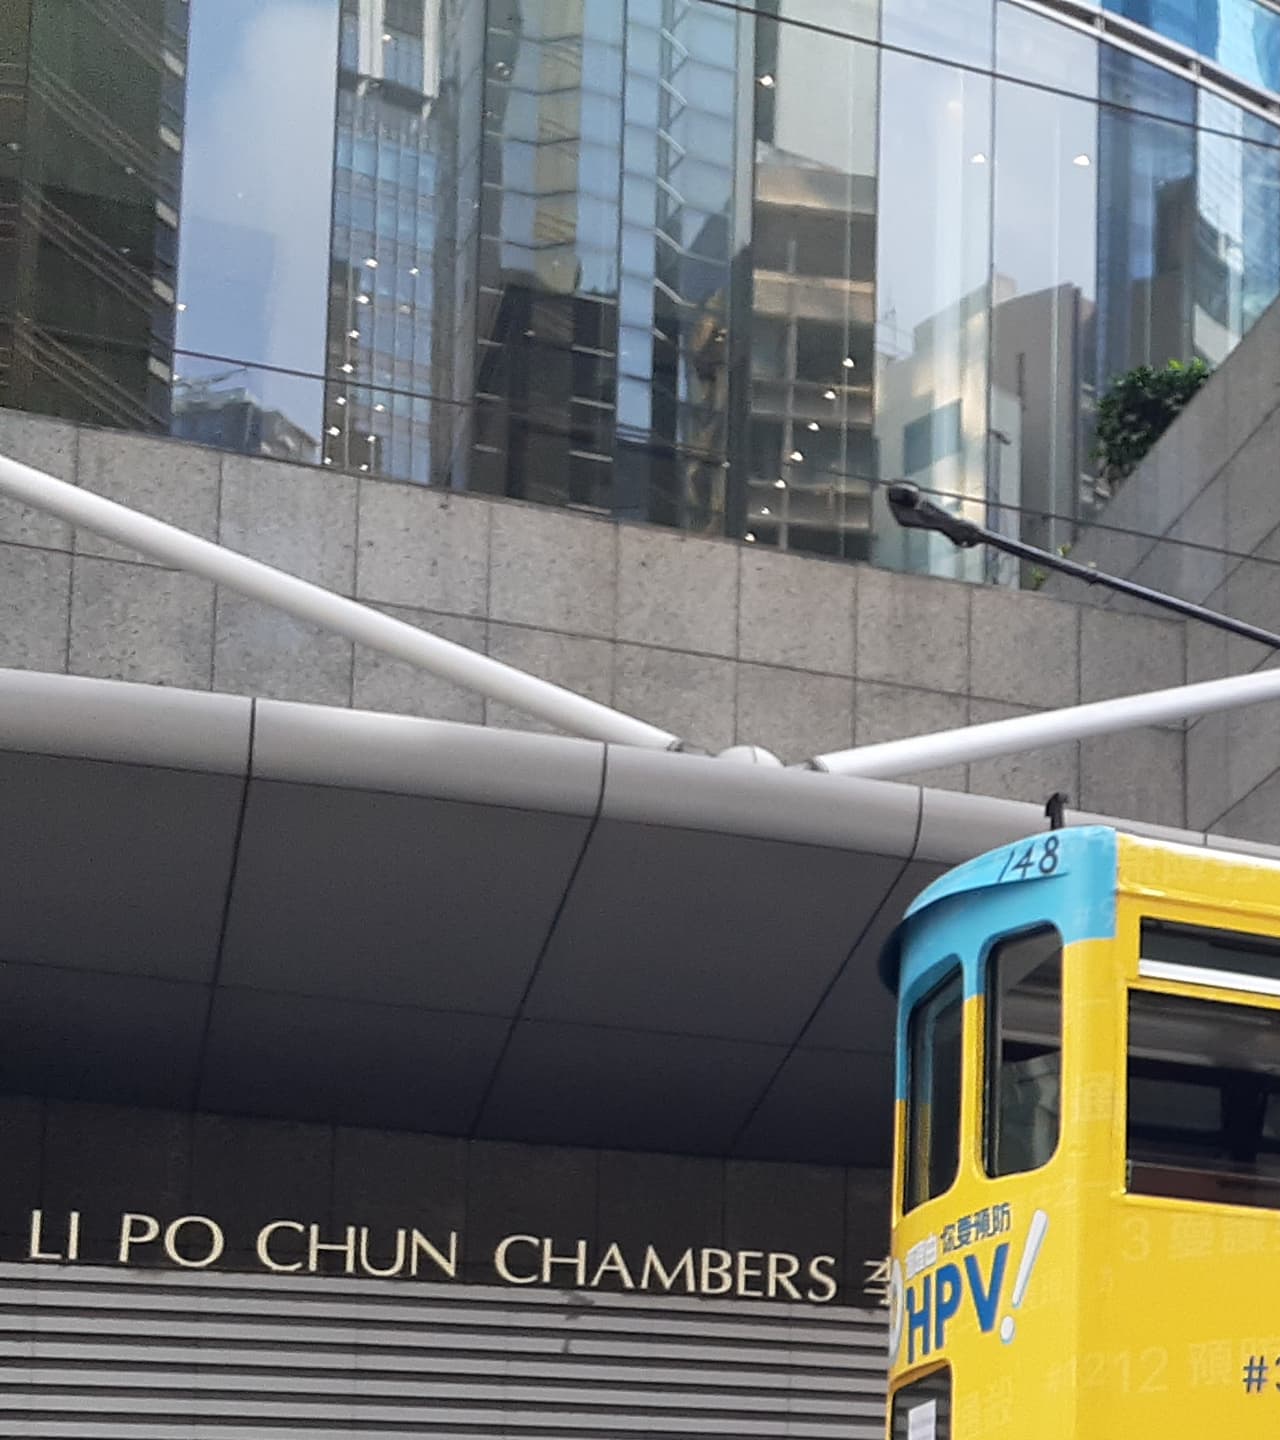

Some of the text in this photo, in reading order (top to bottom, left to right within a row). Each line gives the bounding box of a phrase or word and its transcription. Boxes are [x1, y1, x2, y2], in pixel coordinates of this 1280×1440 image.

[997, 834, 1060, 882] 148
[29, 1209, 80, 1261] LI
[118, 1212, 225, 1268] PO
[256, 1220, 458, 1278] CHUN
[493, 1233, 838, 1302] CHAMBERS
